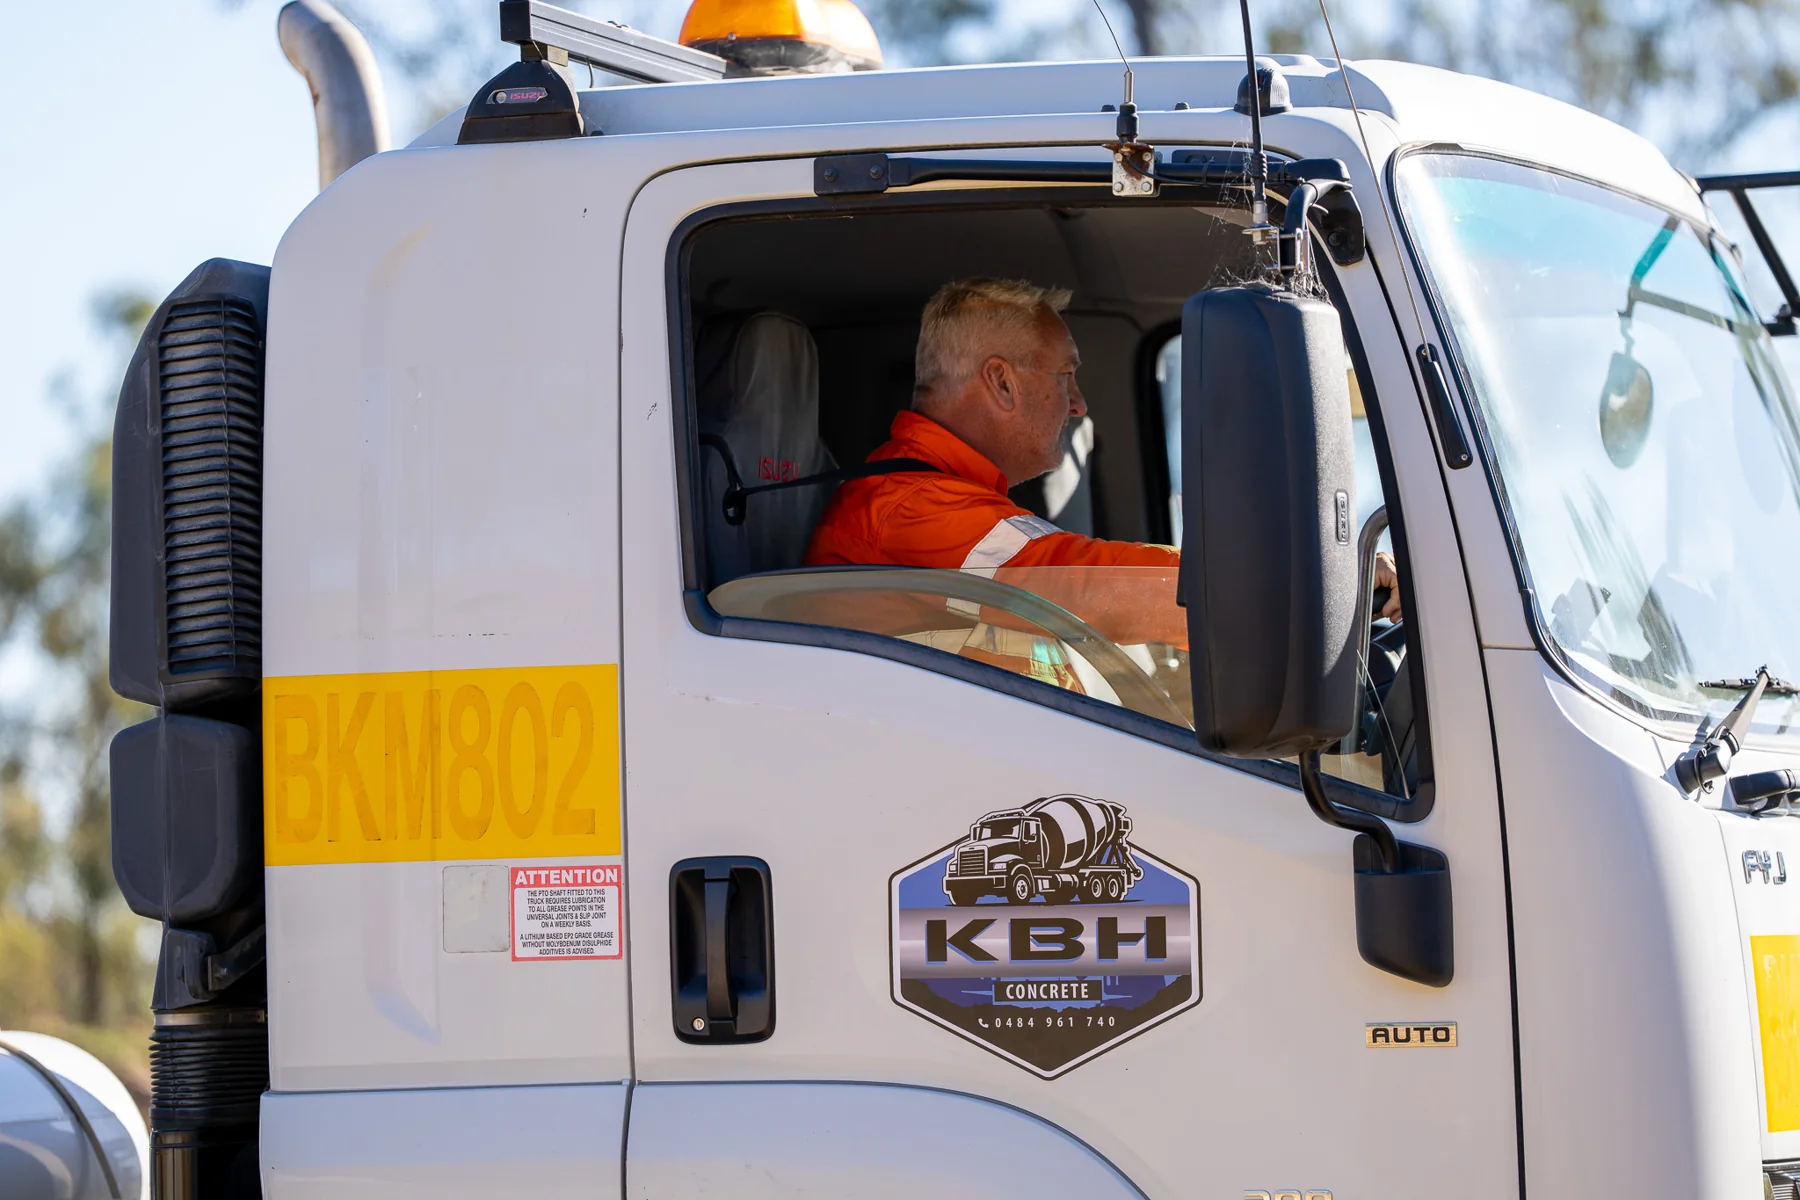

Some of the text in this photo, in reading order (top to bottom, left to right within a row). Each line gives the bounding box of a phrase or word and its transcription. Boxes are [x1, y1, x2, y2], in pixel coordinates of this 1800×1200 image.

[510, 91, 545, 100] ISUZU
[758, 455, 801, 483] ISUZU
[274, 681, 595, 843] BKM802
[515, 868, 618, 885] ATTENTION
[555, 912, 574, 920] JOINTS
[554, 920, 574, 928] WEEKLY
[593, 931, 614, 939] GREASE
[925, 916, 1167, 964] KBH
[582, 939, 612, 947] DISULPHIDE
[1005, 983, 1089, 1000] CONCRETE
[995, 1016, 1115, 1028] 0484 961 740
[1372, 1026, 1450, 1044] AUTO
